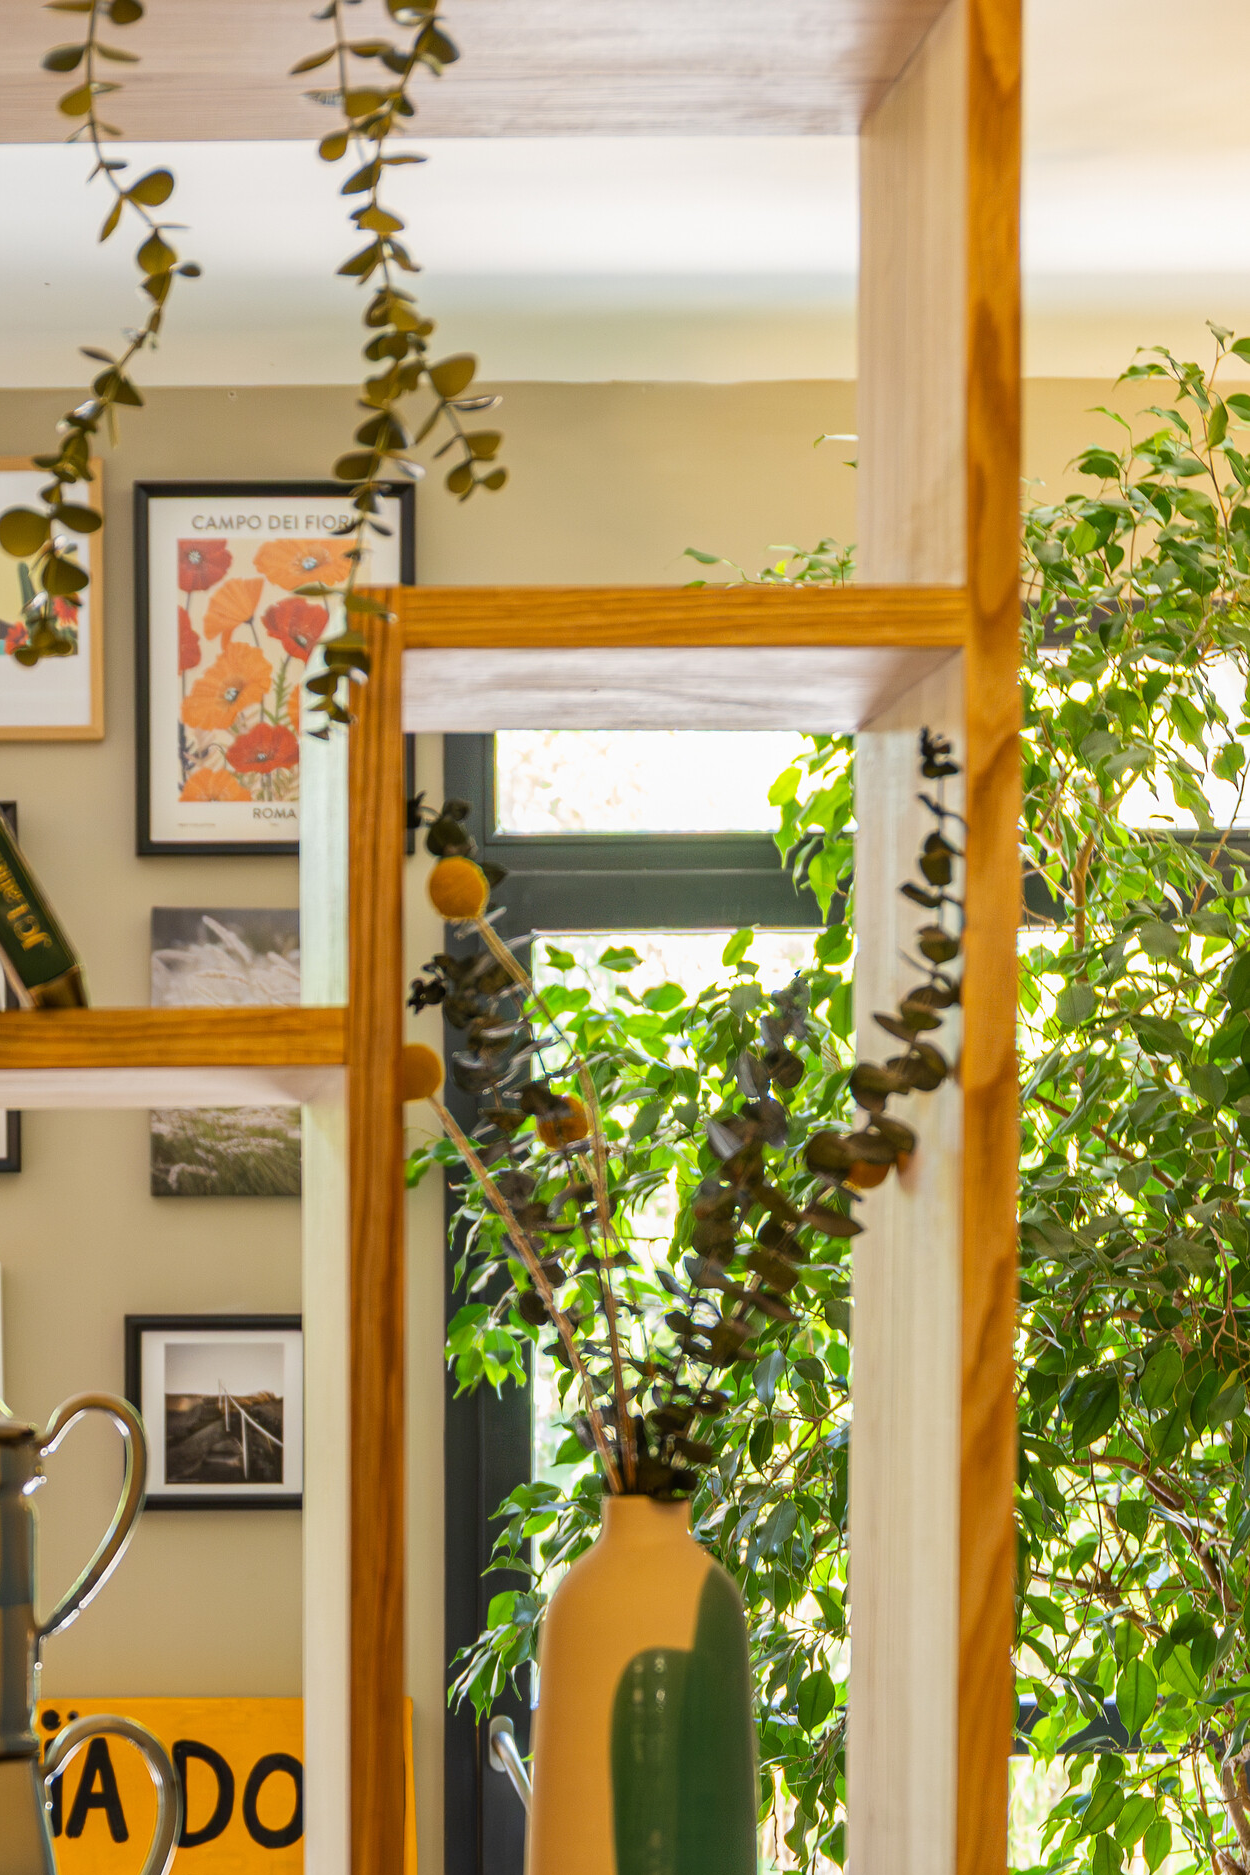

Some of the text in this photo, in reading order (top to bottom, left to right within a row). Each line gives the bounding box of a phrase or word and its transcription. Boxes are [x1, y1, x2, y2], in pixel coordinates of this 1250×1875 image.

[191, 514, 262, 531] CAMPO
[268, 514, 299, 530] DEI
[252, 807, 298, 819] ROMA
